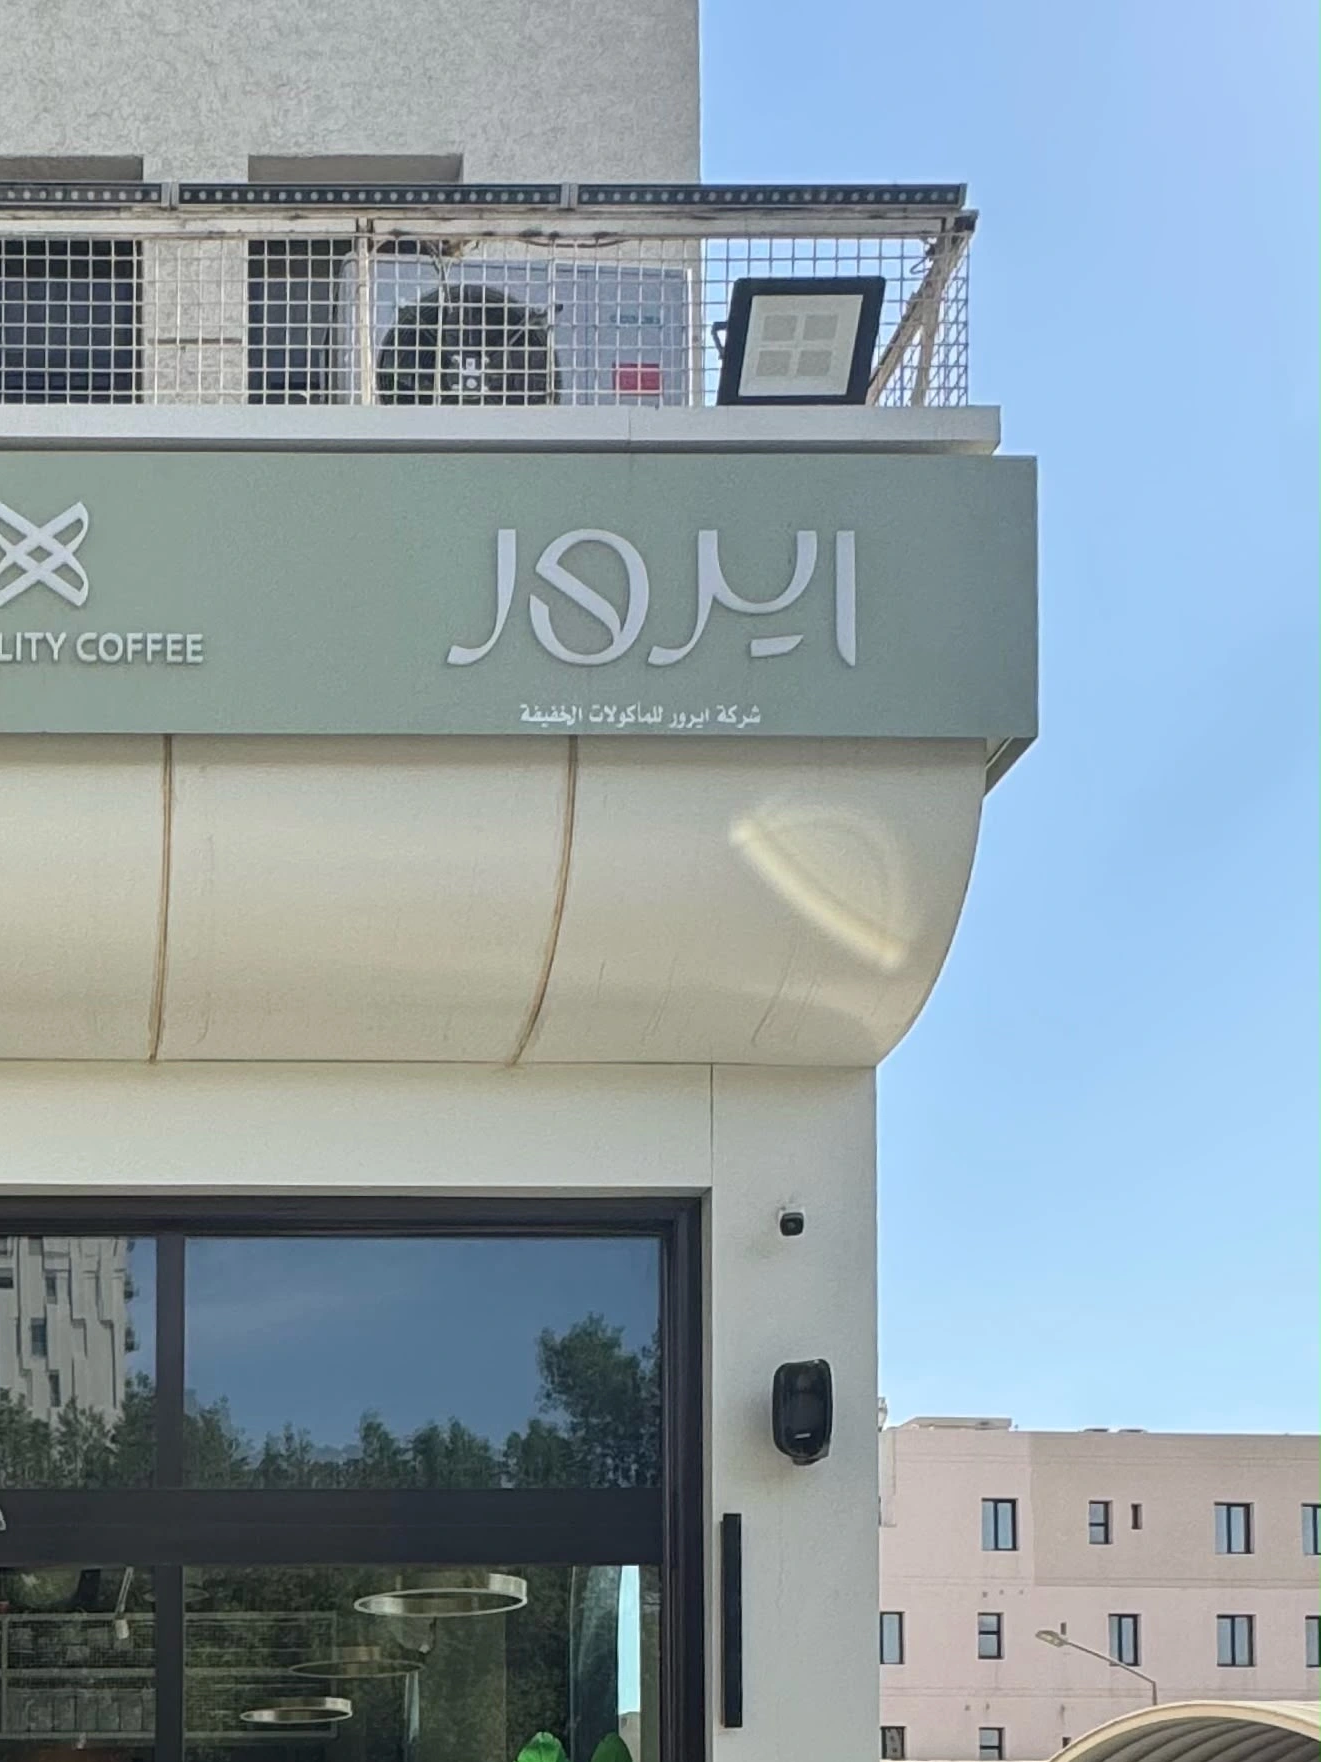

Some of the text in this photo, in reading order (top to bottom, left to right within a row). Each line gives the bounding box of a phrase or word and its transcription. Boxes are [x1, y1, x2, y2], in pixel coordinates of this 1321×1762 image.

[446, 528, 856, 666] ايرور
[75, 632, 204, 662] COFFEE
[519, 703, 583, 728] الخفيفة
[669, 708, 710, 729] ايرور
[716, 704, 761, 729] شركة
